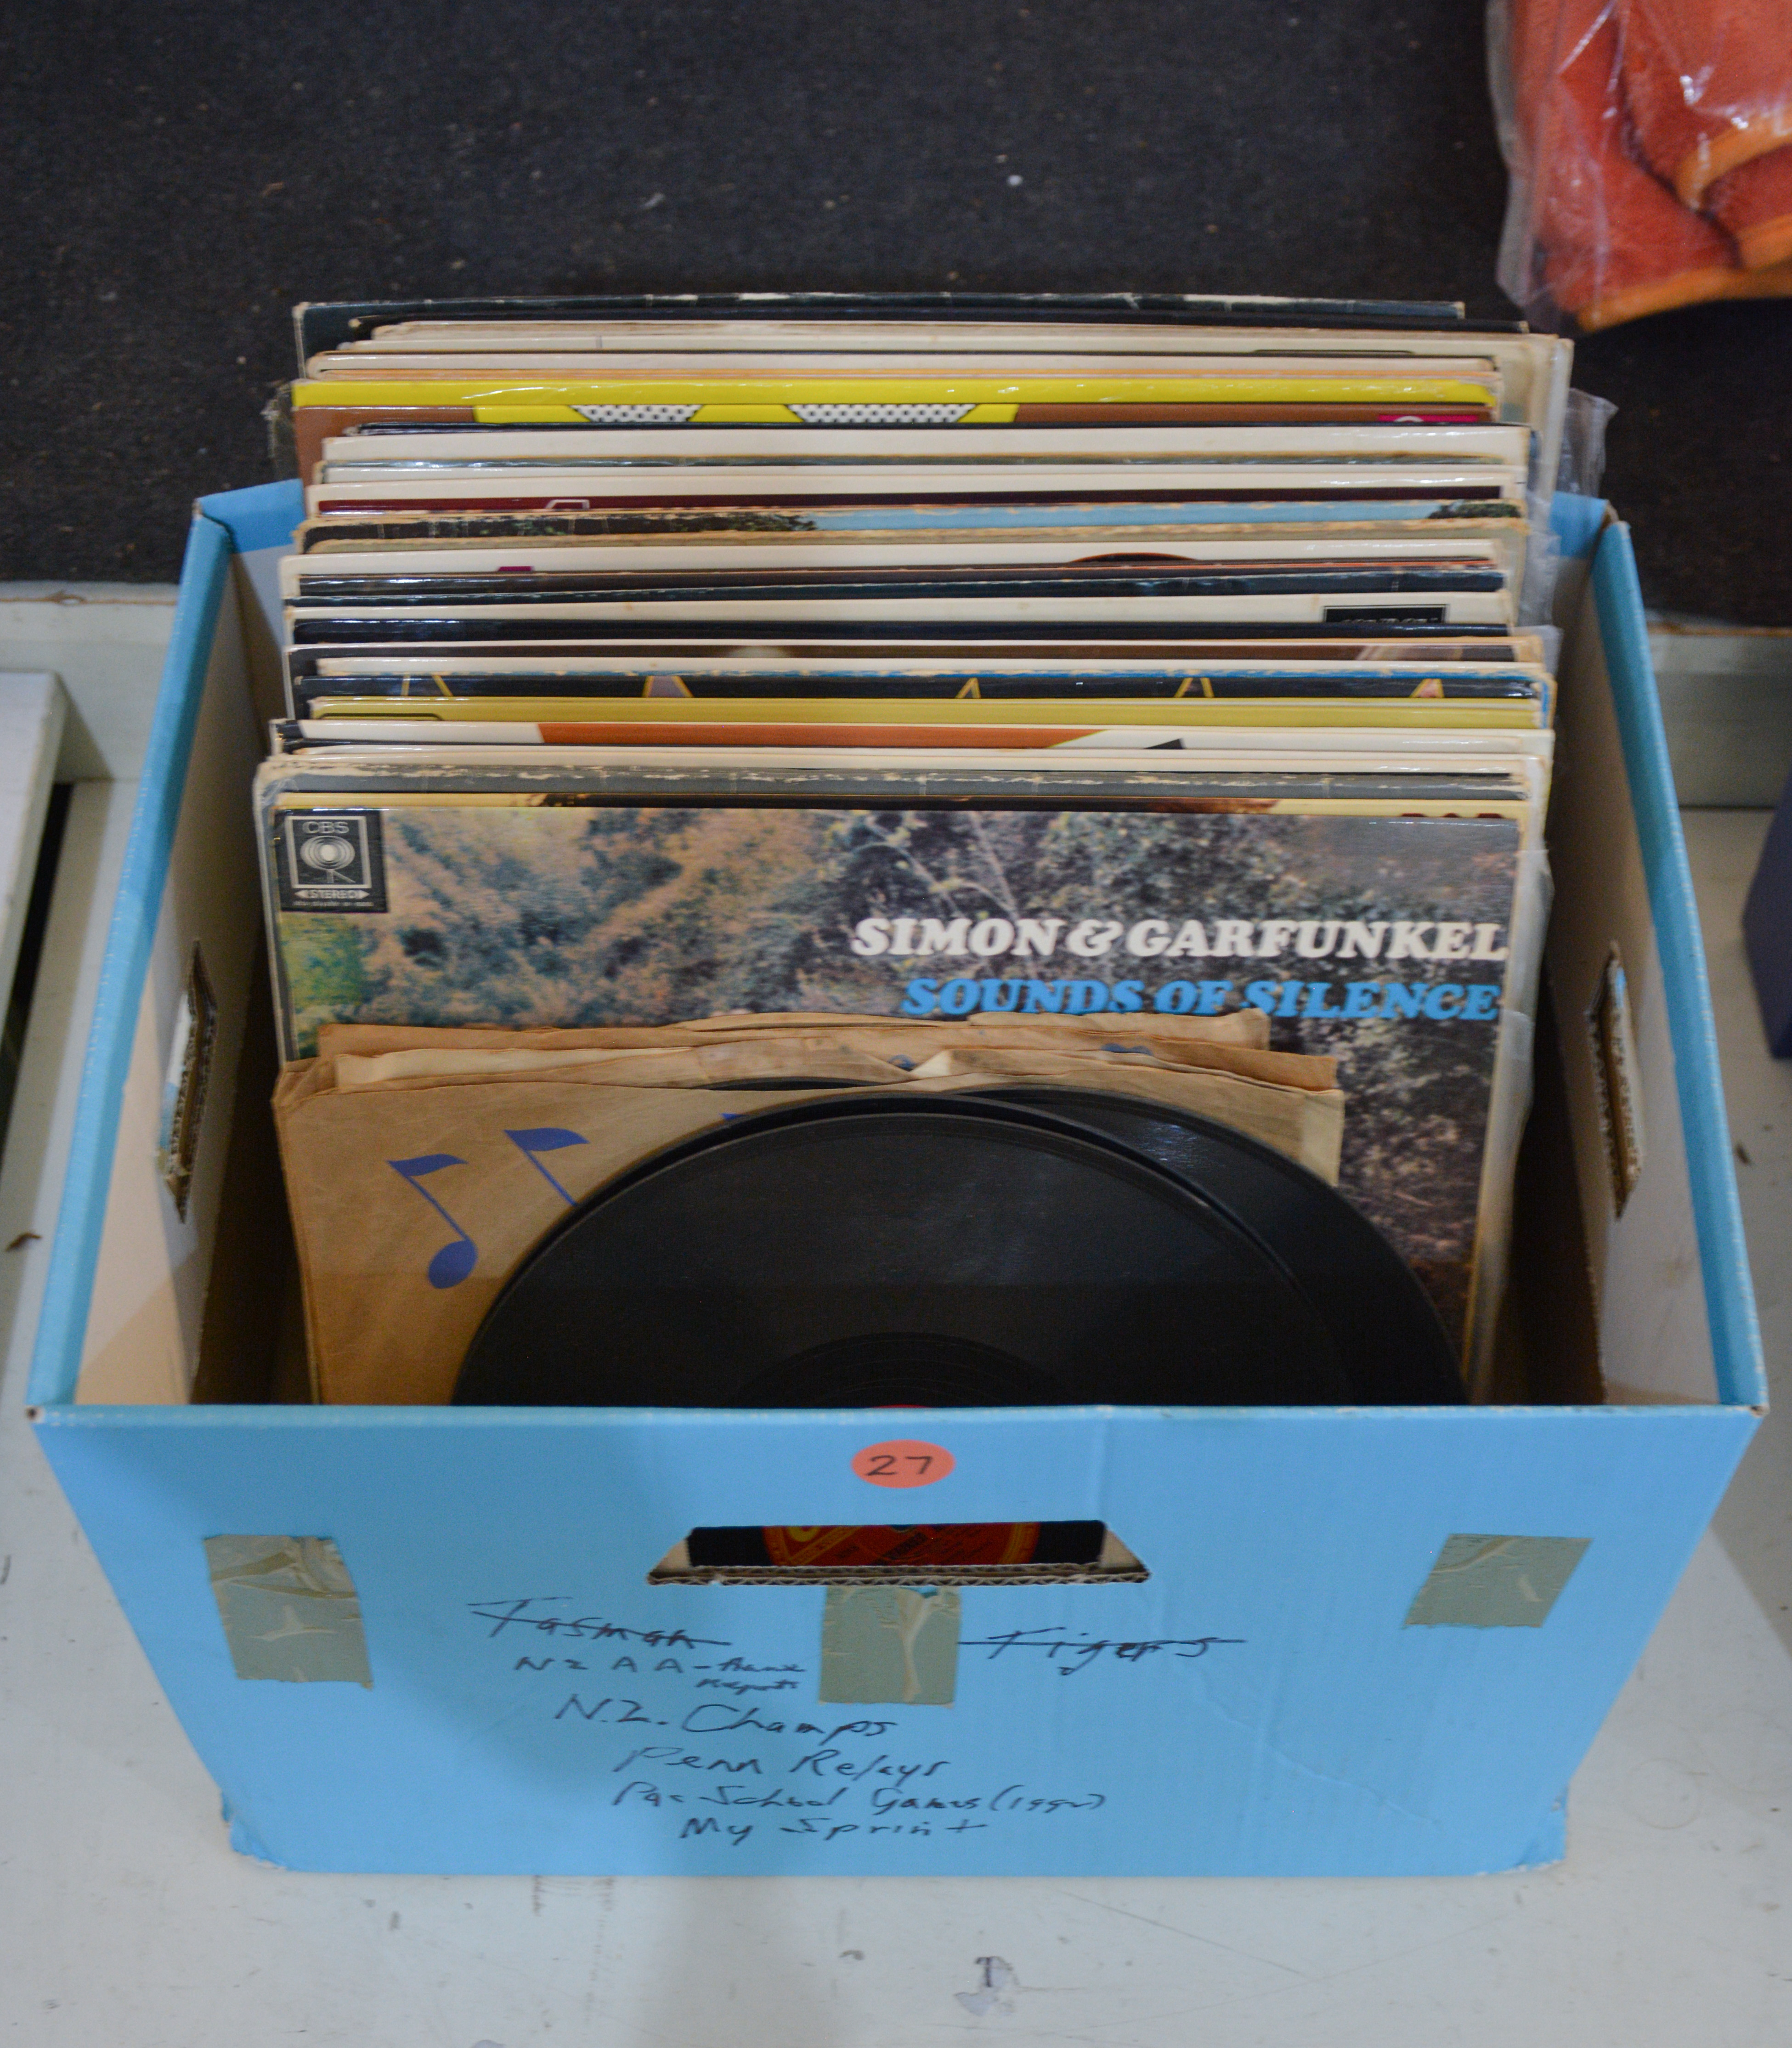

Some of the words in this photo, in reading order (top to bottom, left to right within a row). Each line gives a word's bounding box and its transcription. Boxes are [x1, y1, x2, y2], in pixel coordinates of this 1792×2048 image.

[302, 820, 350, 834] CBS
[307, 889, 358, 899] STEREO
[850, 918, 1066, 956] SIMON
[1065, 919, 1124, 957] &
[1125, 919, 1509, 960] GARFUNKEL
[900, 978, 1145, 1015] SOUNDS
[1153, 980, 1233, 1015] OF
[1240, 981, 1501, 1020] SILENCE
[865, 1455, 933, 1477] 27
[682, 1703, 898, 1745] Champs
[613, 1747, 763, 1774] Penn
[679, 1817, 754, 1845] My
